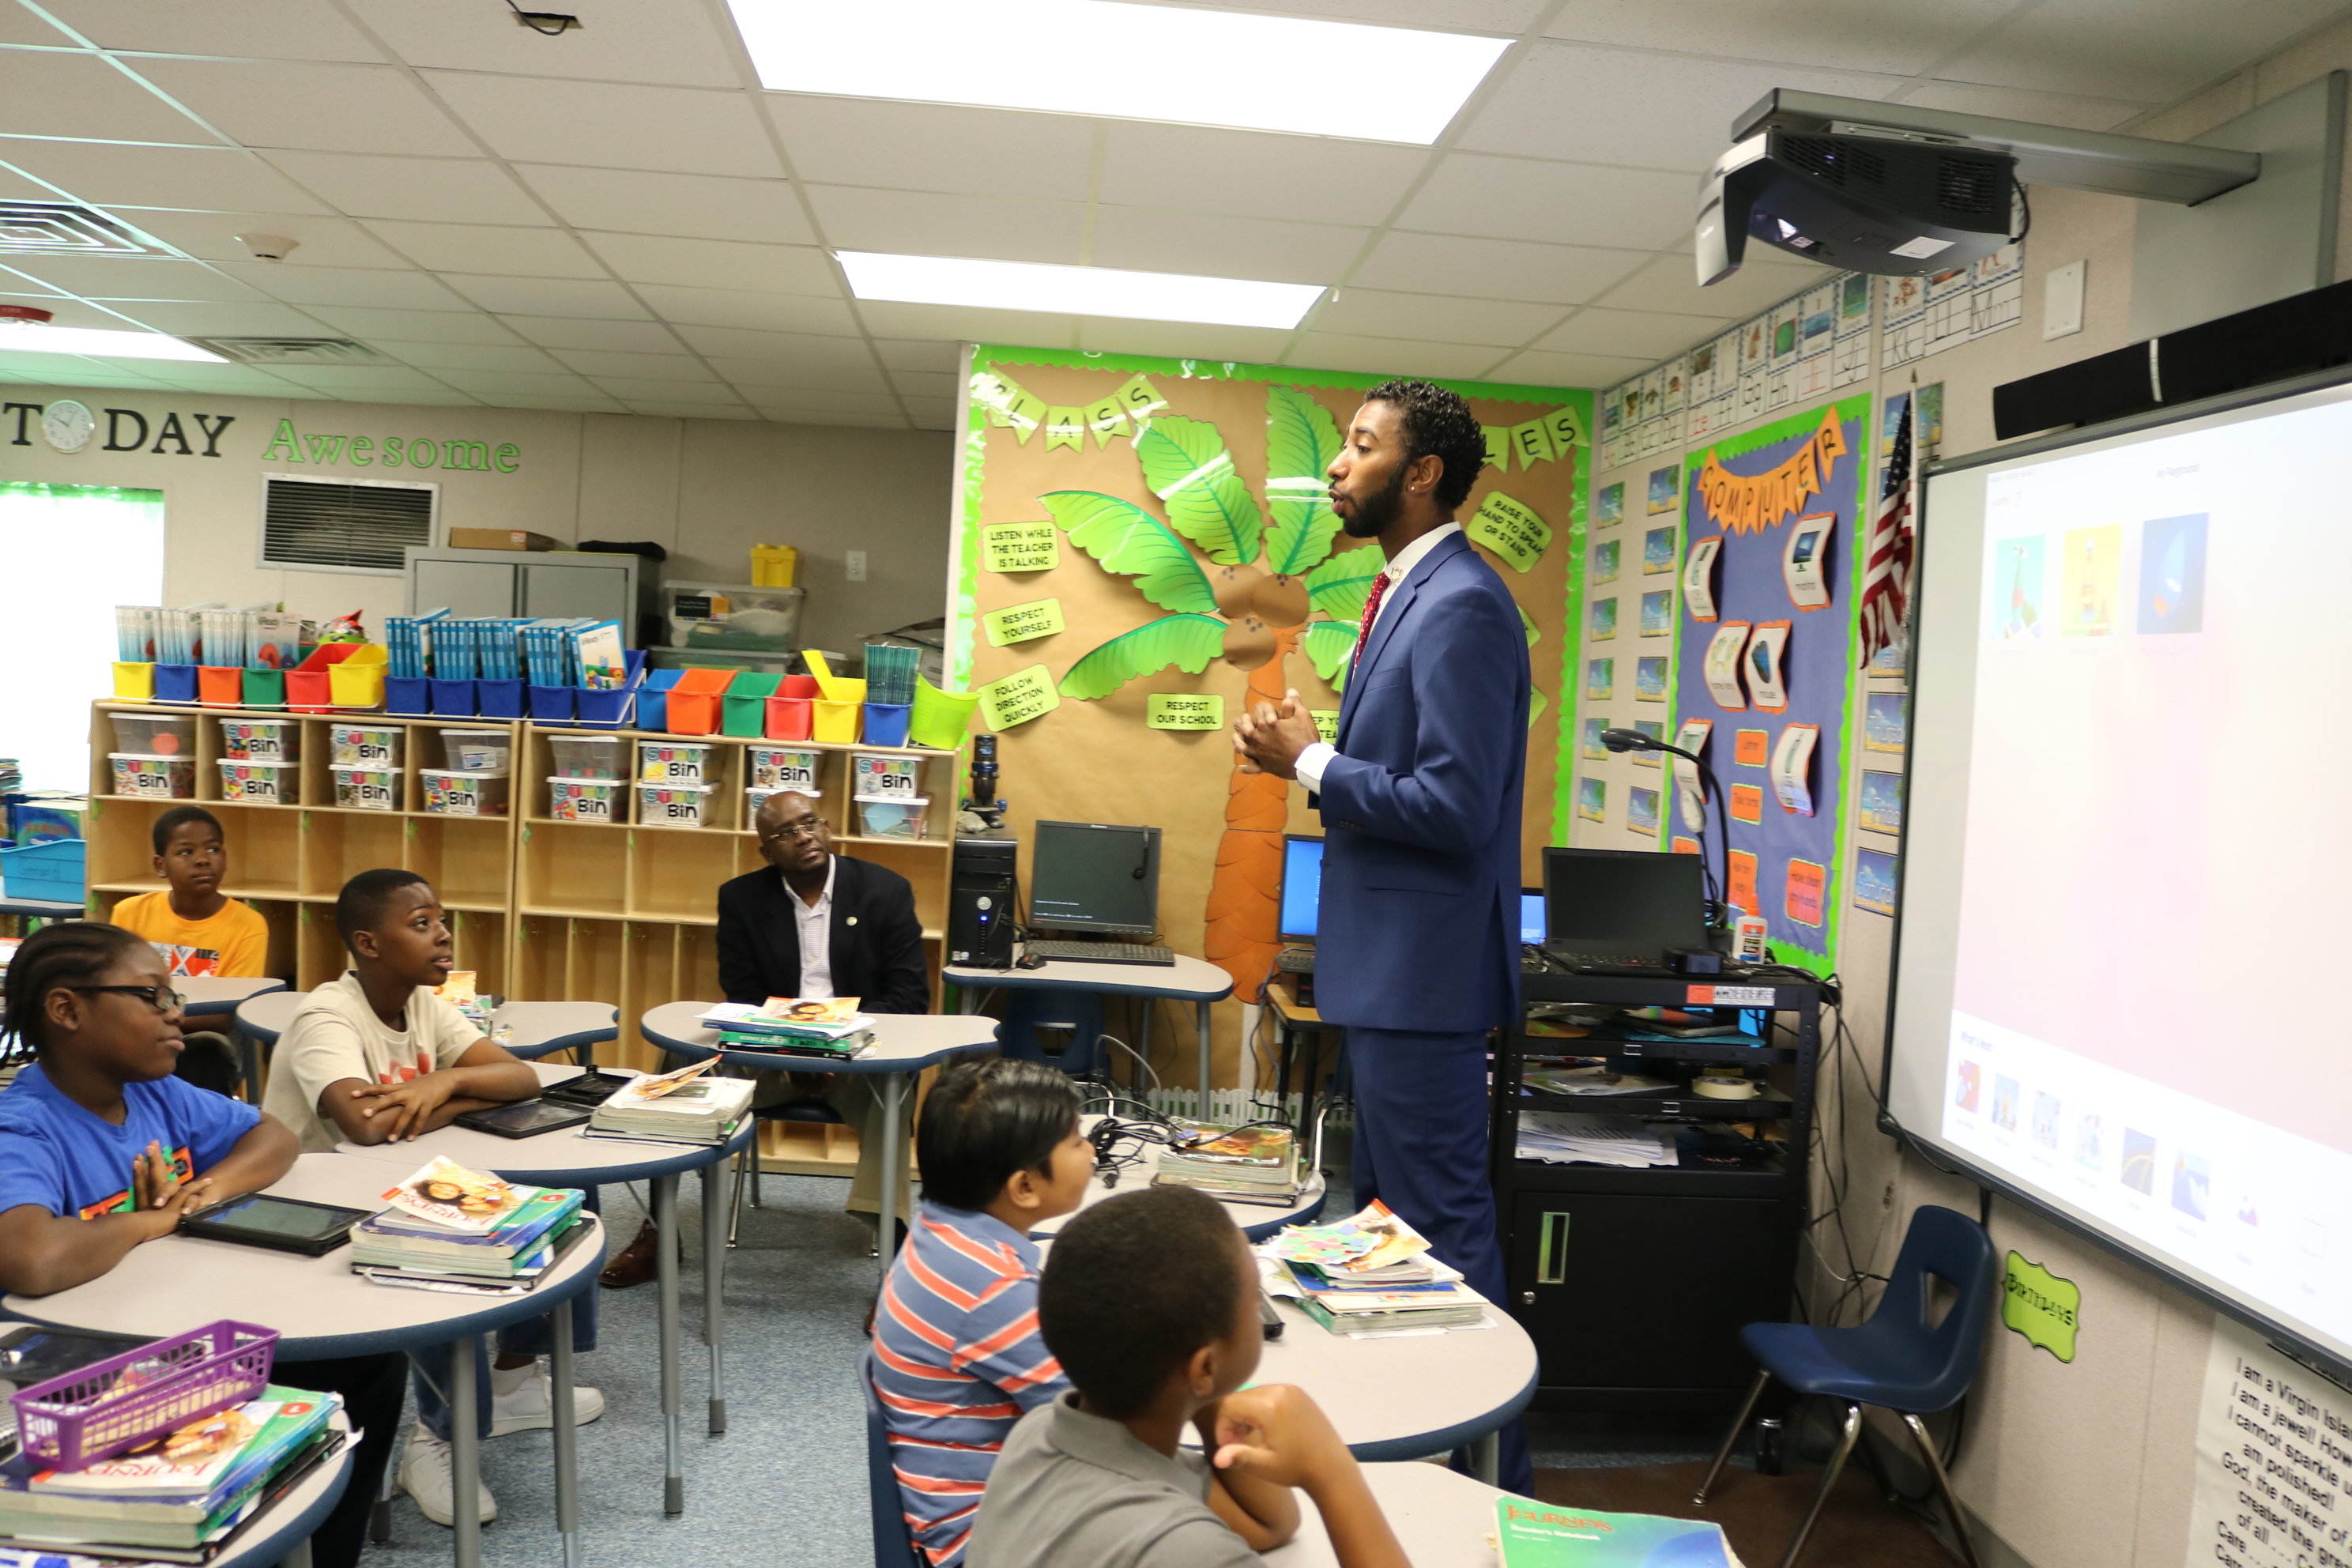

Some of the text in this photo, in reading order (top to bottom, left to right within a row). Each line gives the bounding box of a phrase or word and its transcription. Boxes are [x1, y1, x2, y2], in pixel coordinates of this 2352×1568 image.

[262, 418, 521, 473] Awesome
[1702, 428, 1837, 518] COMPUTER
[1493, 499, 1544, 540] RAISE YOUR
[990, 529, 1054, 541] LISTEN WHILE
[1478, 505, 1544, 556] HAND TO SPEAK
[992, 542, 1054, 554] THE TEACHER
[1484, 524, 1528, 557] OR STAND
[999, 556, 1050, 567] IS TALKING
[1002, 608, 1045, 624] RESPECT
[1002, 620, 1052, 639] YOURSELF
[994, 675, 1034, 698] FOLLOW
[996, 686, 1044, 711] DIRECTION
[1166, 701, 1210, 711] RESPECT
[1004, 700, 1043, 722] QUICKLY
[1156, 714, 1217, 725] OUR SCHOOL
[227, 724, 278, 740] STEM
[335, 729, 392, 746] STEM
[248, 739, 279, 752] Bin
[358, 744, 388, 760] Bin
[646, 747, 702, 763] STEM
[757, 752, 813, 768] STEM
[116, 759, 168, 775] STEM
[224, 764, 277, 782] STEM
[669, 763, 699, 777] Bin
[780, 767, 810, 782] Bin
[858, 760, 915, 775] STEM
[138, 774, 169, 788] Bin
[338, 771, 392, 786] STEM
[424, 776, 477, 792] STEM
[881, 775, 912, 790] Bin
[246, 781, 276, 795] Bin
[361, 786, 390, 801] Bin
[555, 782, 609, 800] STEM
[448, 791, 475, 806] Bin
[644, 788, 700, 805] STEM
[577, 799, 607, 814] Bin
[667, 803, 698, 819] Bin
[2236, 1357, 2242, 1373] I
[2244, 1366, 2263, 1386] am
[2266, 1379, 2274, 1393] a
[2278, 1381, 2320, 1421] Virgin
[2231, 1381, 2238, 1396] I
[2240, 1390, 2260, 1411] am
[2263, 1403, 2271, 1418] a
[2227, 1404, 2233, 1420] I
[2236, 1413, 2282, 1452] cannot
[2285, 1444, 2339, 1487] sparkle
[2243, 1444, 2263, 1465] am
[2223, 1452, 2349, 1547] God, the maker of
[1505, 1504, 1613, 1532] JOURNEYS
[2239, 1491, 2288, 1534] created
[2292, 1525, 2314, 1552] the
[2218, 1520, 2247, 1554] Care
[2237, 1513, 2270, 1546] of all
